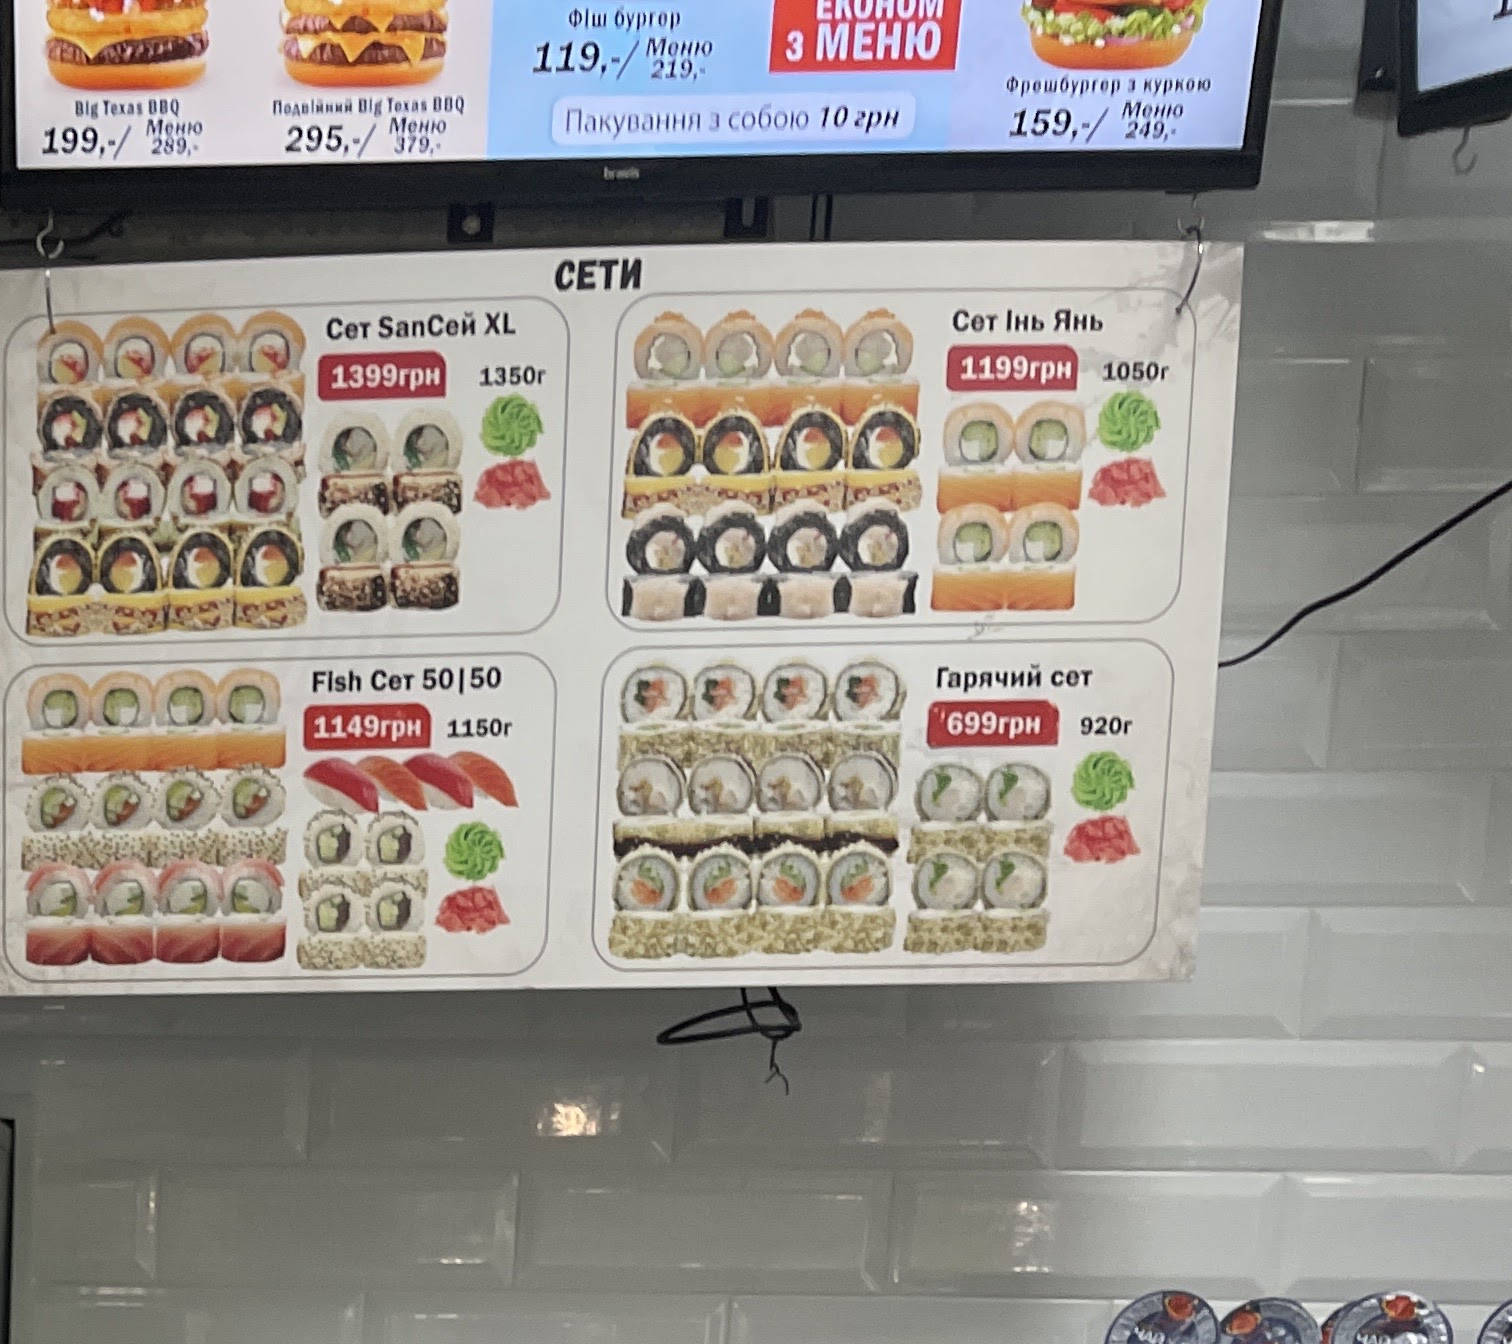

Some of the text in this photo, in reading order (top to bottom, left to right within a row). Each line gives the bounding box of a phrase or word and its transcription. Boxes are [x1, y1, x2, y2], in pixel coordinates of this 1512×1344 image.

[569, 6, 681, 33] Фіш бургер
[816, 0, 945, 20] ЕКОНОМ
[646, 37, 713, 58] Меню
[816, 21, 942, 61] МЕНЮ
[1006, 75, 1121, 95] Фрешбургер
[1143, 75, 1211, 95] куркою
[75, 99, 180, 118] Big Texas BBQ
[272, 97, 465, 118] Подвійний Big Texas BBQ
[1122, 101, 1184, 119] Меню
[145, 118, 203, 137] Меню
[388, 117, 446, 135] Меню
[566, 107, 702, 139] Пакування
[728, 105, 809, 131] собою
[819, 105, 849, 128] 10
[853, 109, 900, 131] грн
[554, 258, 643, 292] СЕТИ
[326, 317, 370, 342] Сет
[485, 311, 517, 336] XL
[952, 309, 1104, 333] Сет Інь Янь
[331, 364, 546, 394] 1399грн 1350г
[960, 355, 1170, 386] 1199грн 1050г
[312, 666, 502, 695] Fish Сет 50|50
[936, 663, 1093, 693] Гарячий сет
[313, 714, 513, 742] 1149грн 1150г
[946, 711, 1133, 740] 699грн 920г
